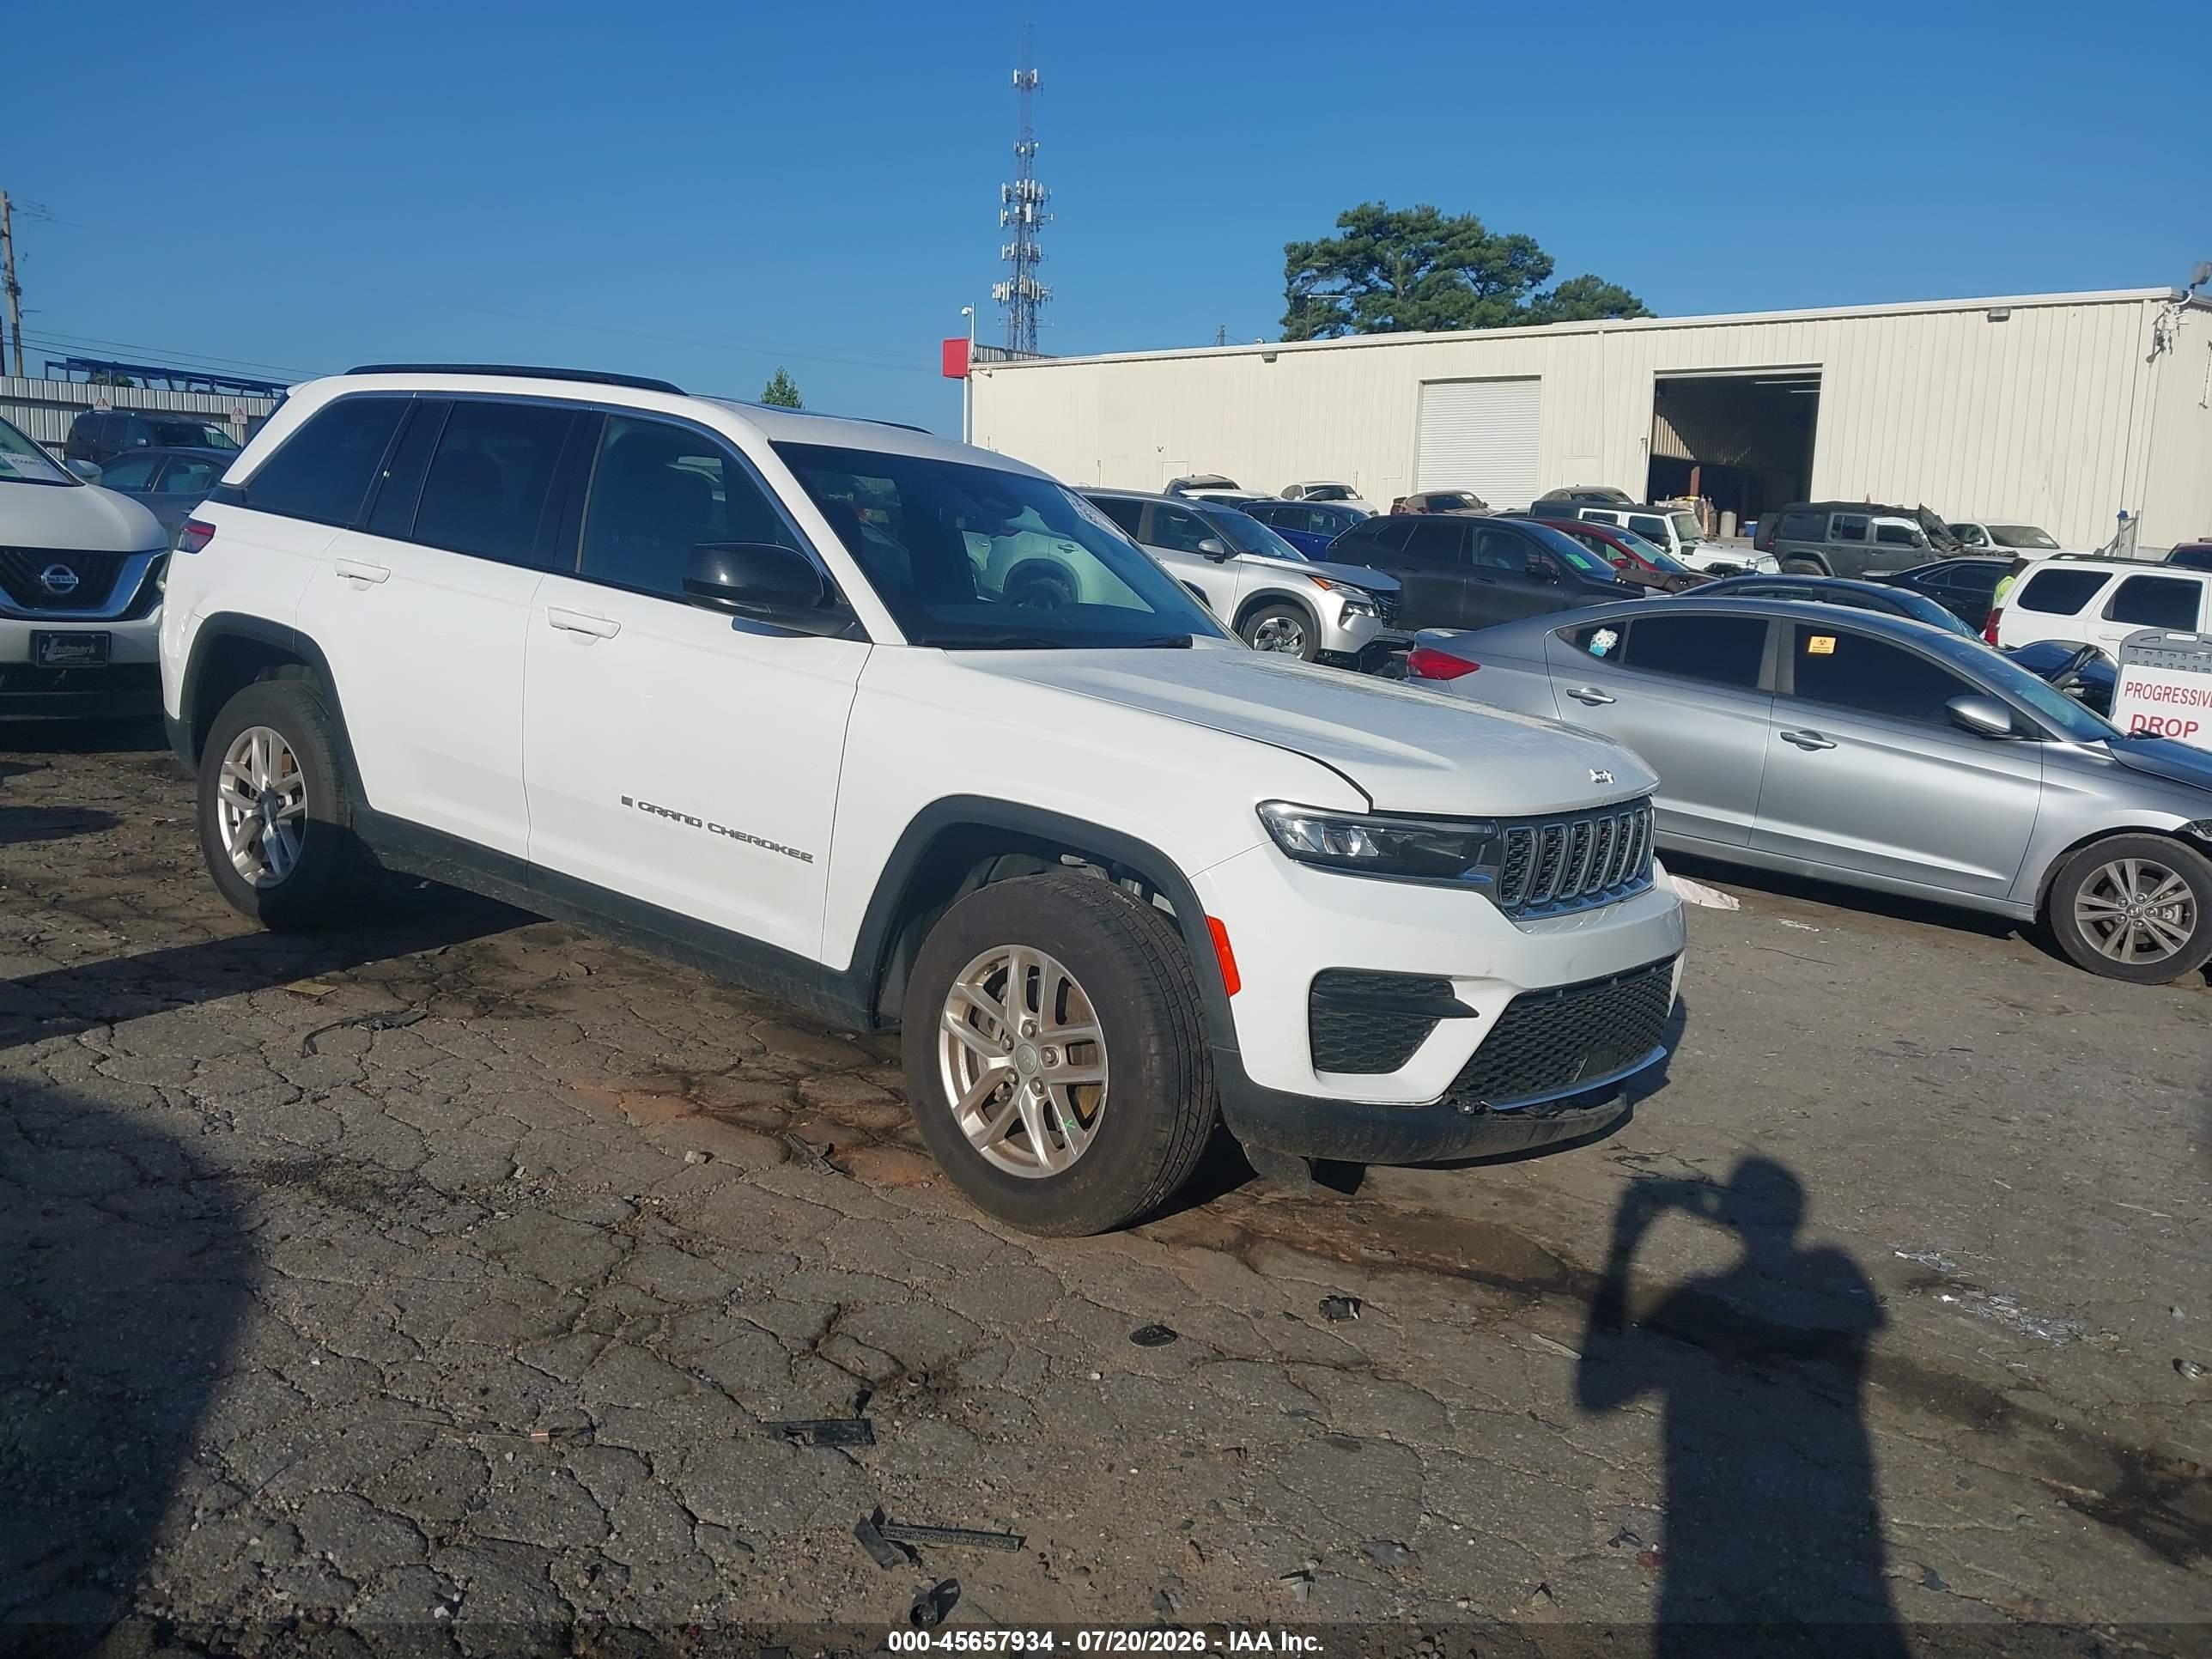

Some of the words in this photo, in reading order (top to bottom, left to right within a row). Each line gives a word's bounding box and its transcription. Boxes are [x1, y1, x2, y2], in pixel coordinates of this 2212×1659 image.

[41, 643, 96, 654] Landmark
[2130, 714, 2199, 738] DROP
[637, 800, 702, 829] GRAND
[707, 821, 814, 865] CHEROKEE
